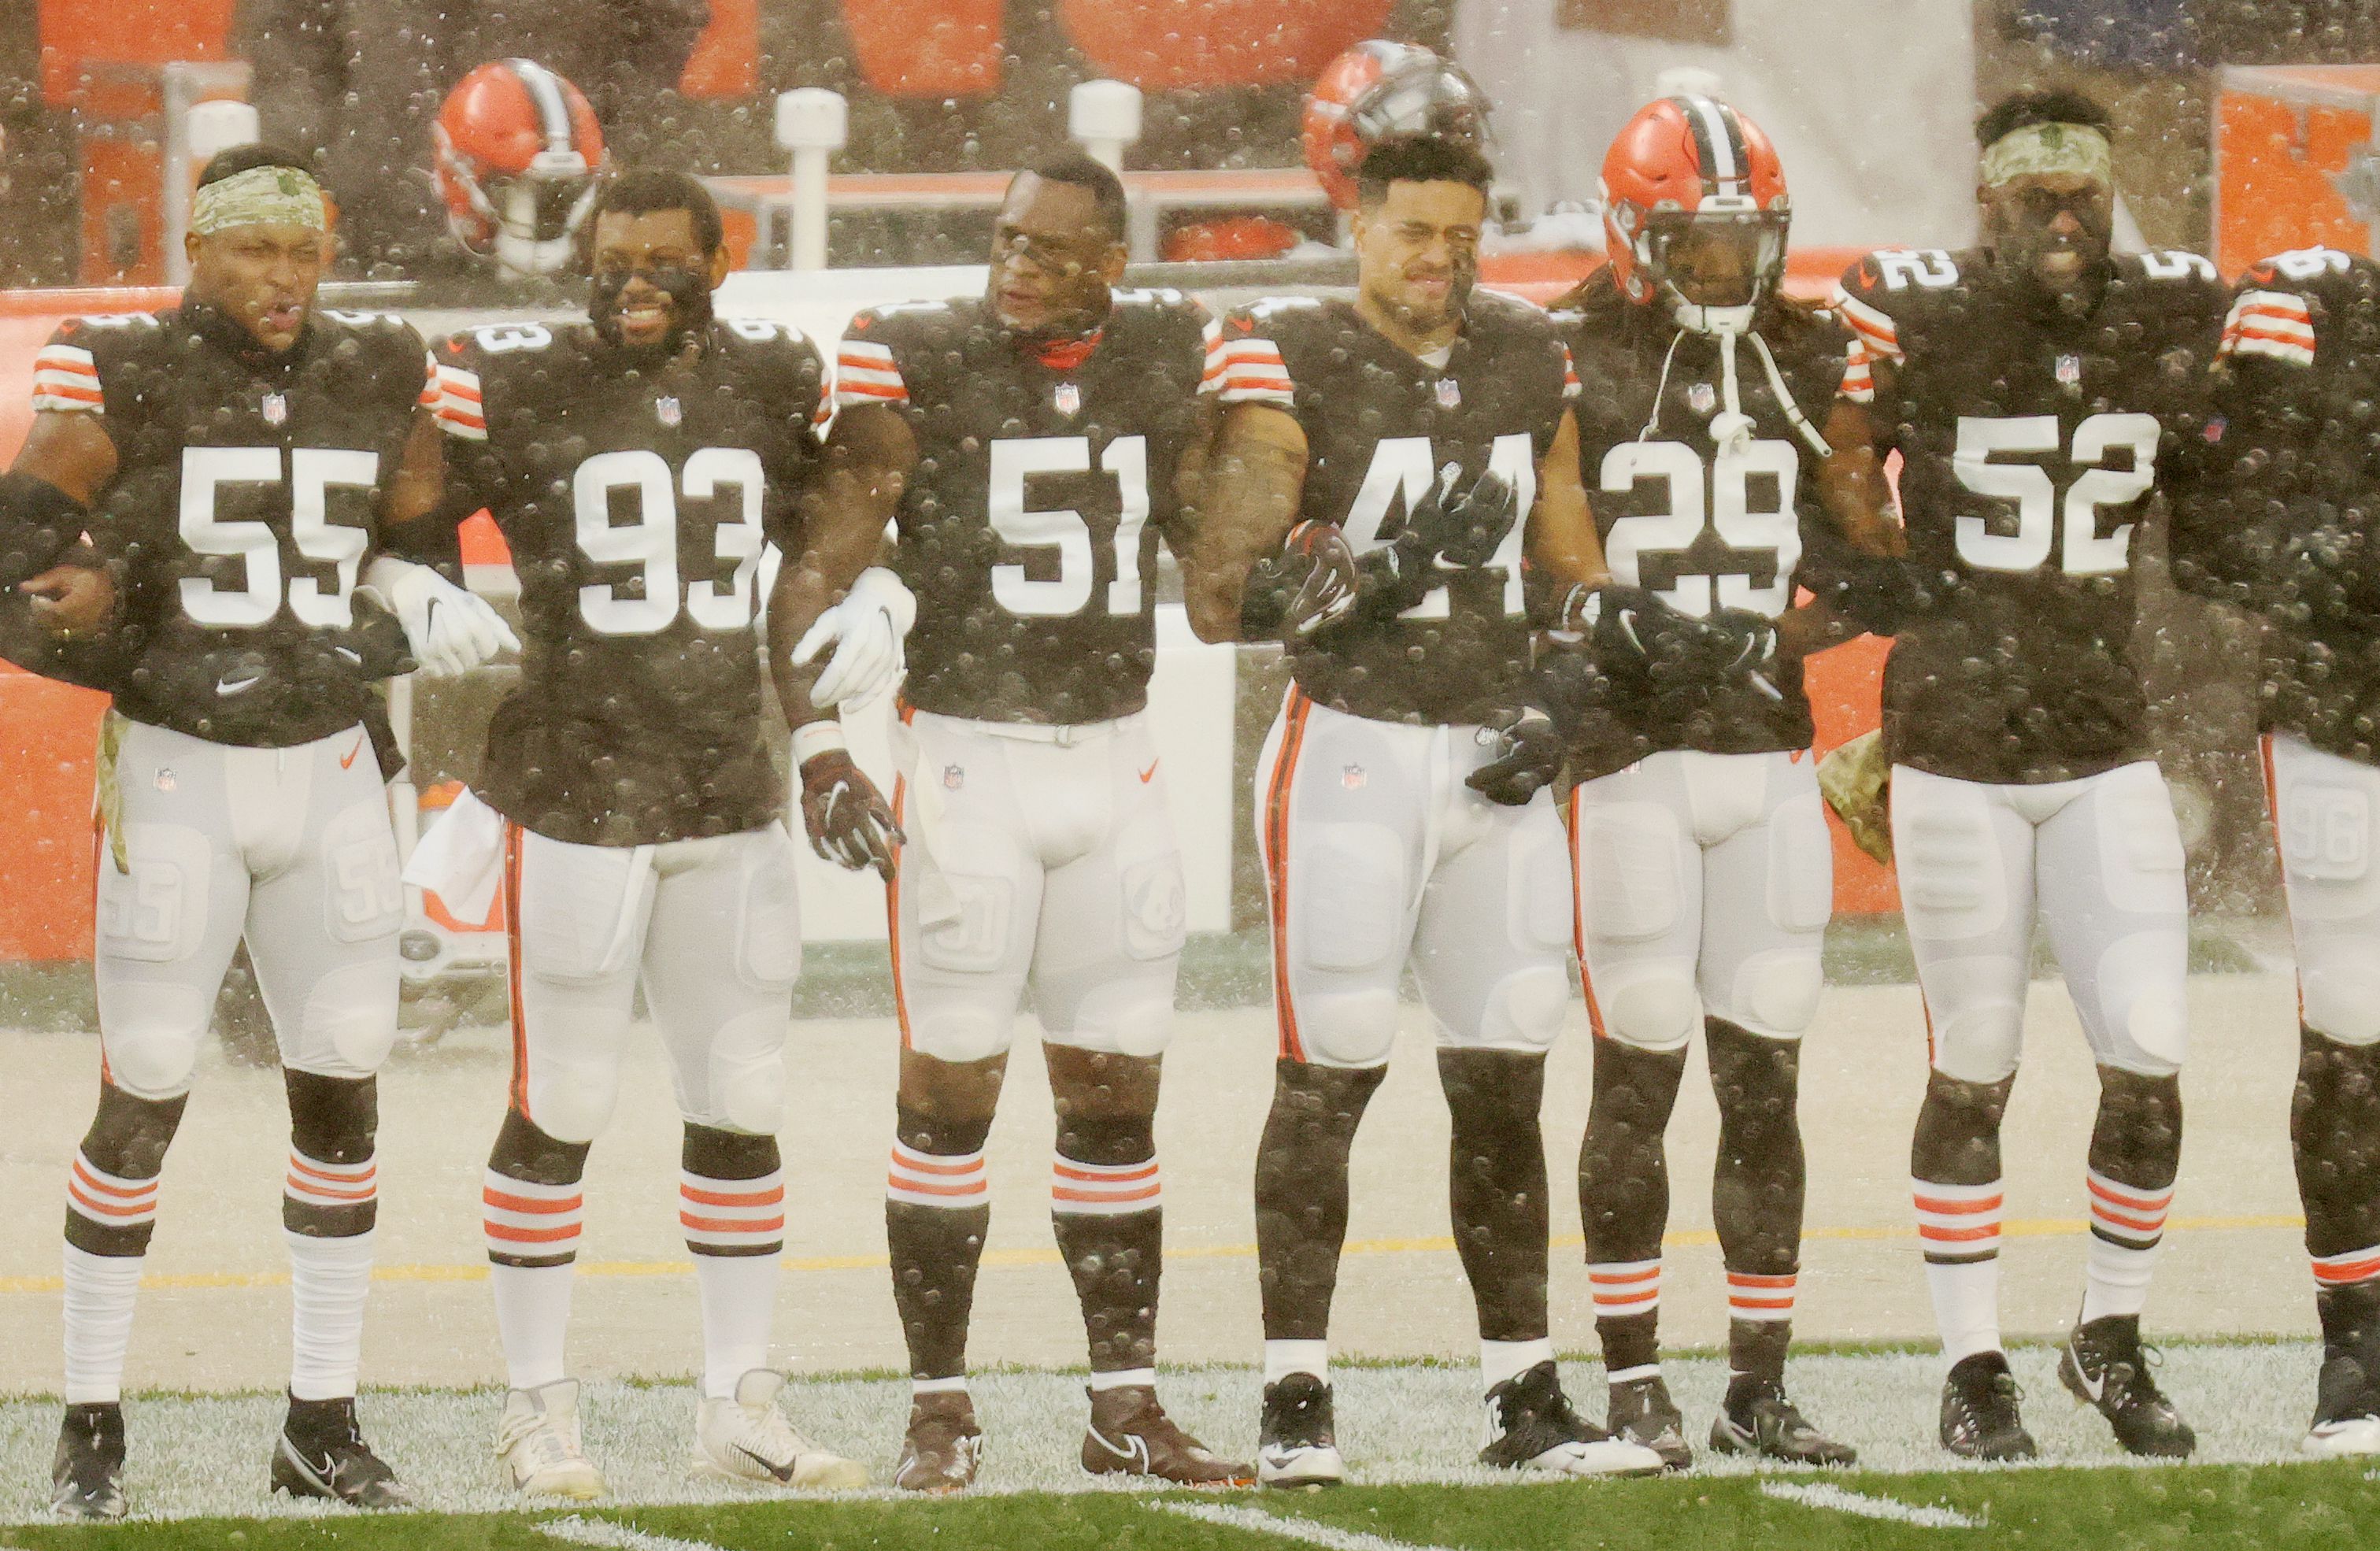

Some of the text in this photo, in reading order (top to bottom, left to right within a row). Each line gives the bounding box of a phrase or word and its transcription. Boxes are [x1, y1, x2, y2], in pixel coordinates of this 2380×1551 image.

[179, 446, 379, 628] 55
[574, 446, 766, 635] 93
[988, 435, 1150, 617] 51
[1600, 439, 1803, 619] 29
[1952, 413, 2162, 576] 52
